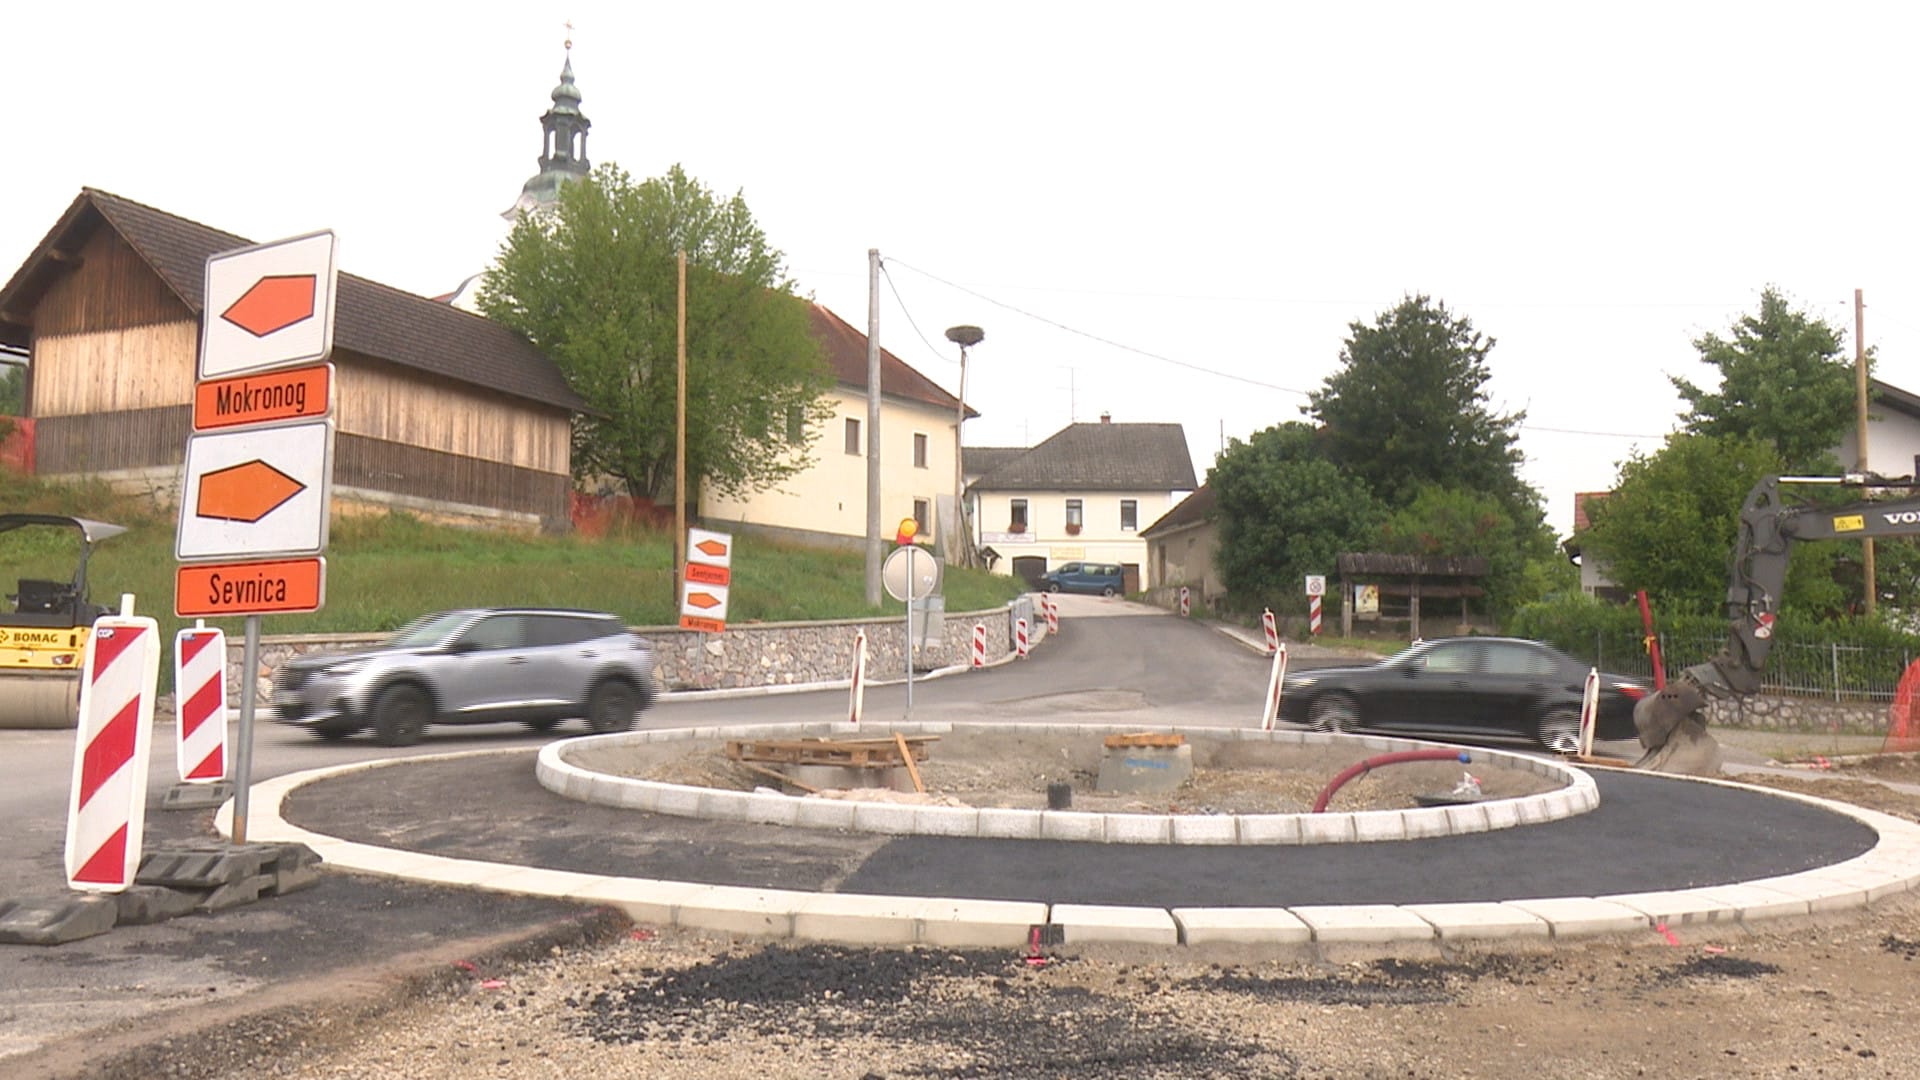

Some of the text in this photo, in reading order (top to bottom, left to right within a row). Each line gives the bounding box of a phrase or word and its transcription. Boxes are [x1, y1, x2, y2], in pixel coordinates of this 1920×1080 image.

[216, 381, 306, 416] Mokronog
[208, 572, 286, 605] Sevnica
[13, 632, 58, 643] BOMAG
